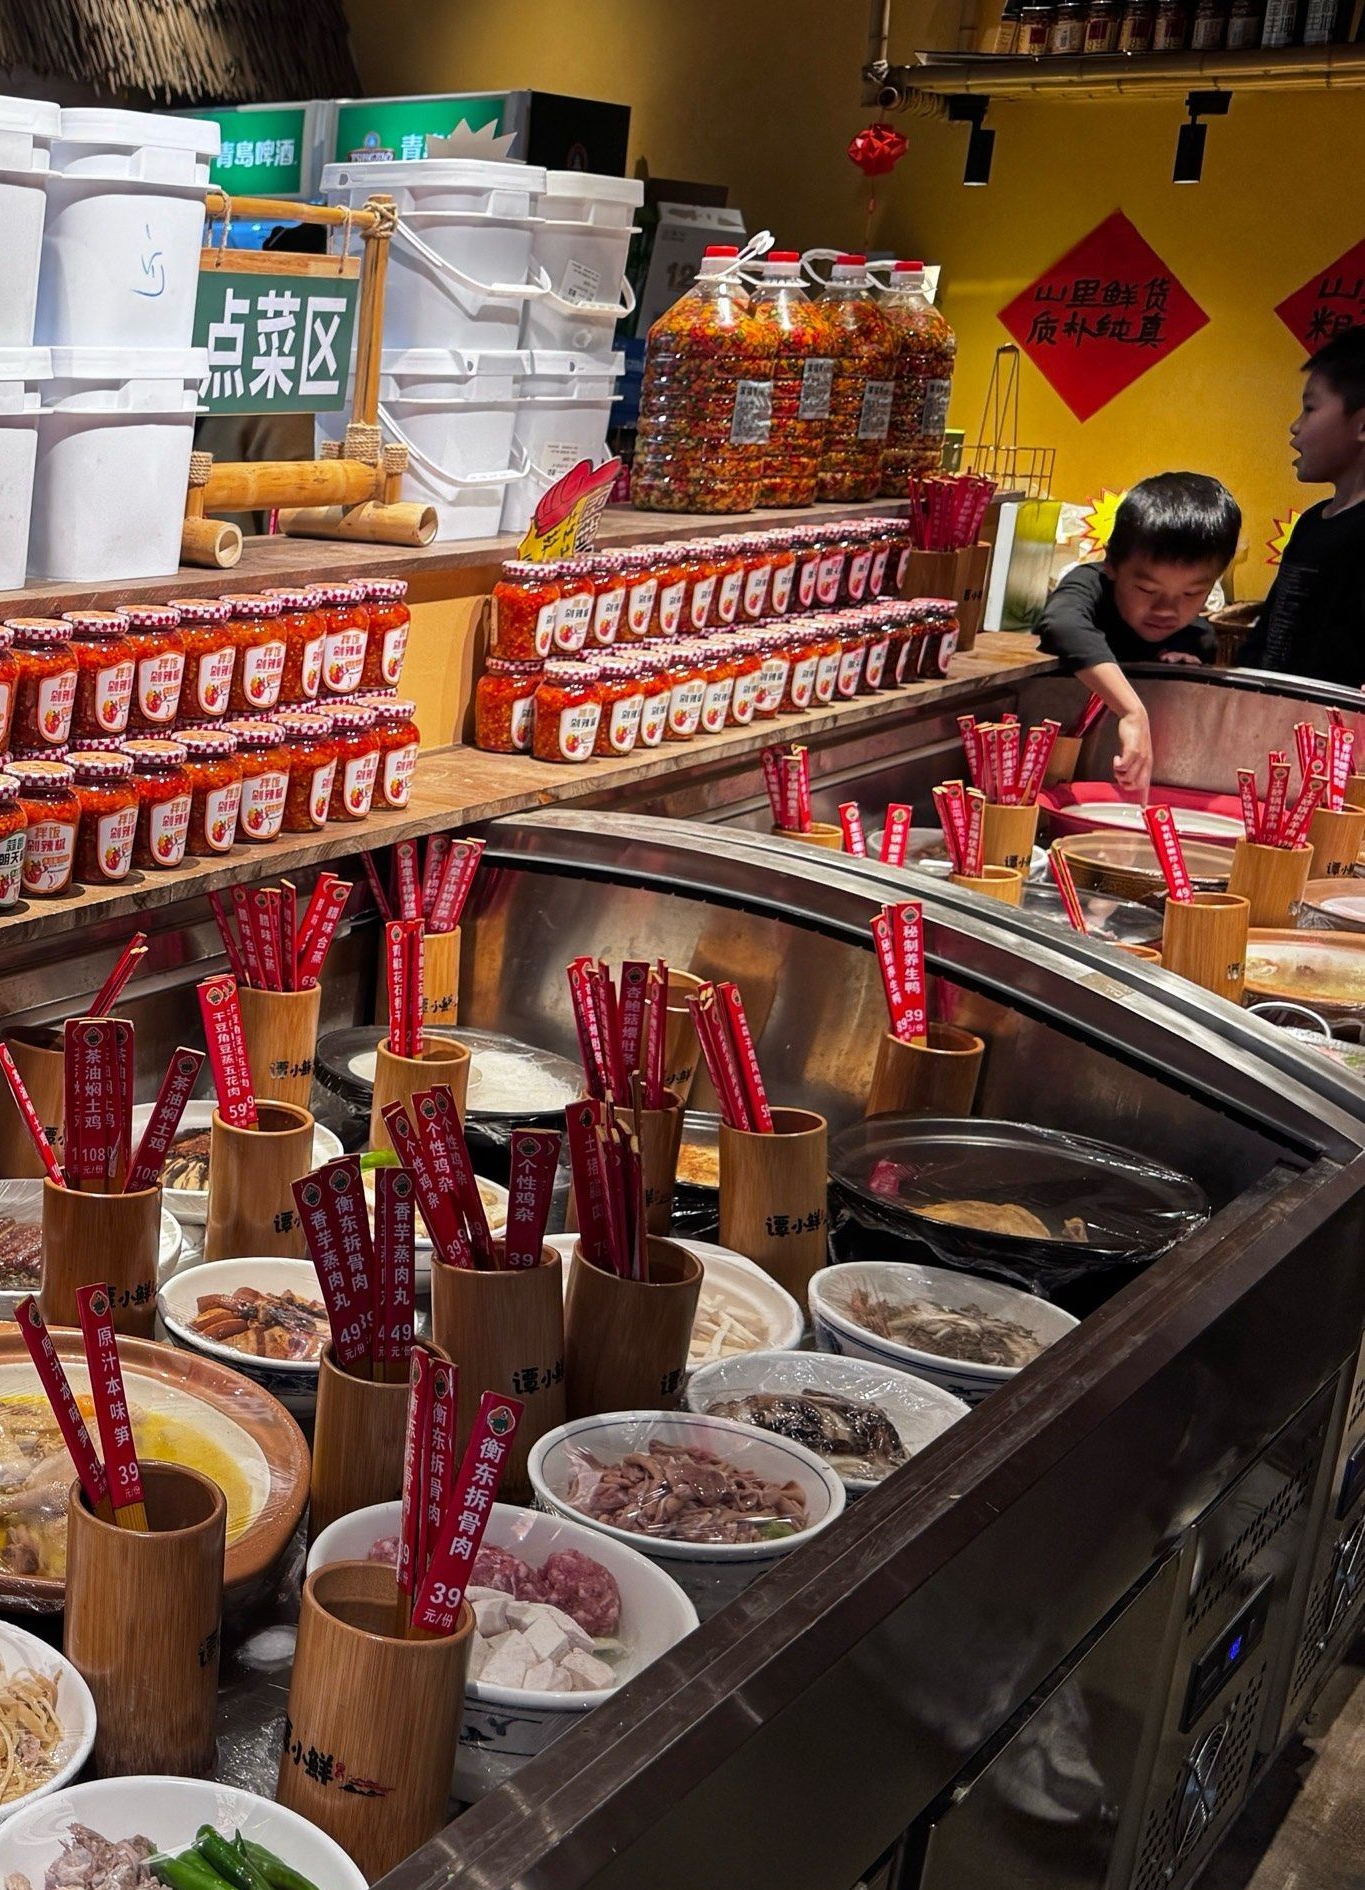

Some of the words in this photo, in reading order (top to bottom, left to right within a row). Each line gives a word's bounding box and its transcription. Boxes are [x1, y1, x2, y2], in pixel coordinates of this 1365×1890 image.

[1035, 277, 1170, 312] 山里鲜货
[203, 289, 346, 399] 点菜区
[1026, 311, 1168, 348] 质朴纯真
[27, 838, 65, 851] 剁辣椒
[35, 826, 61, 839] 拌饭
[302, 976, 316, 986] 69
[85, 1049, 101, 1129] 茶油焖土鸡
[148, 1076, 189, 1152] 茶油焖土鸡
[83, 1148, 105, 1161] 108
[426, 1121, 454, 1193] 个性鸡杂
[516, 1158, 537, 1222] 个性鸡杂
[310, 1211, 351, 1311] 香芋蒸肉丸
[335, 1196, 369, 1292] 衡东拆骨肉
[394, 1202, 410, 1306] 香芋蒸肉丸
[509, 1253, 534, 1267] 39
[340, 1324, 361, 1344] 49
[391, 1324, 411, 1341] 49
[97, 1326, 129, 1448] 原汁本味笋
[119, 1463, 139, 1485] 39
[449, 1437, 506, 1561] 衡东拆骨肉
[429, 1582, 462, 1608] 39
[423, 1608, 454, 1628] 元/份
